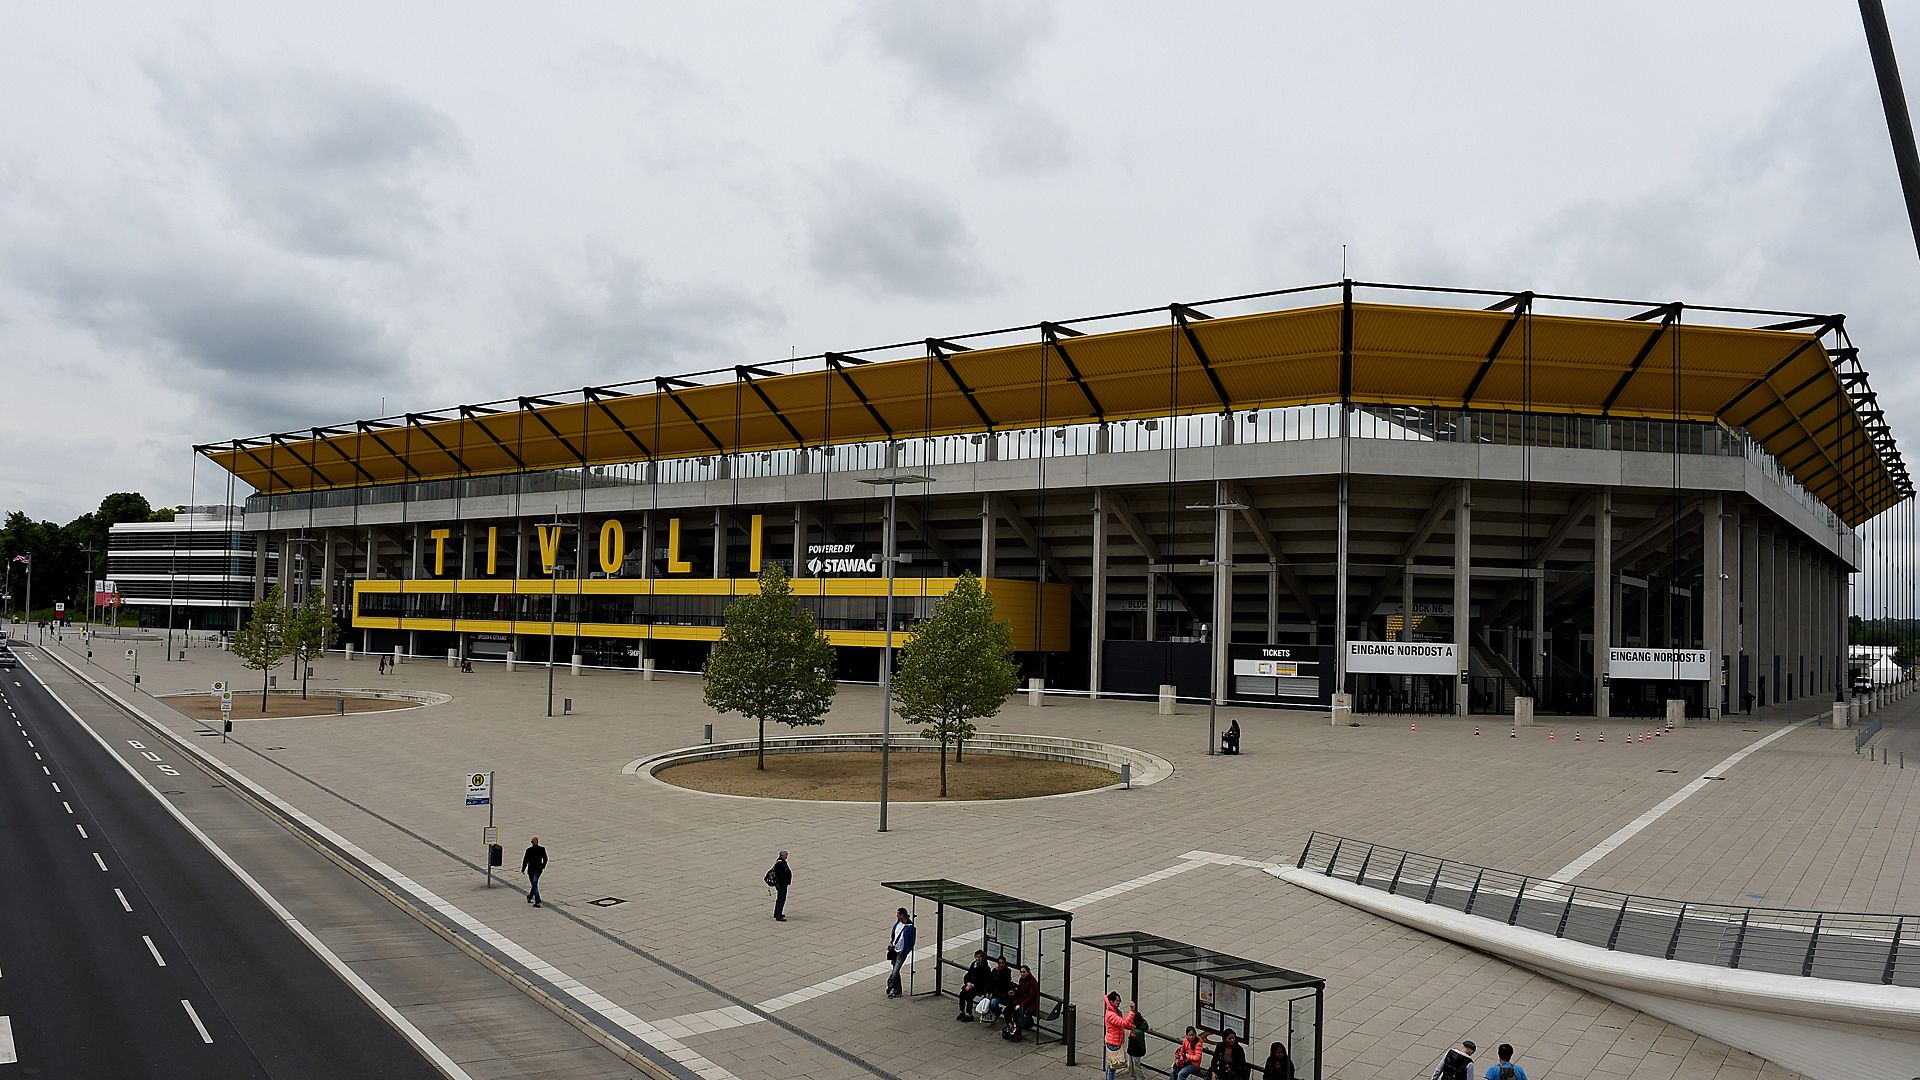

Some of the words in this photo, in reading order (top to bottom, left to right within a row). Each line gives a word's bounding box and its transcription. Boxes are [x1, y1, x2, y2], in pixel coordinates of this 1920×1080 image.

[430, 514, 764, 576] TIVOLI
[808, 544, 843, 554] POWERED
[844, 544, 855, 553] BY
[822, 558, 876, 573] STAWAG
[1128, 600, 1147, 609] BLOC
[1262, 649, 1290, 657] TICKETS
[1351, 644, 1394, 655] EINGANG
[1397, 645, 1443, 656] NORDOST
[1445, 646, 1453, 657] A
[1610, 651, 1651, 662] EINGANG
[1653, 652, 1697, 663] NORDOST
[1699, 653, 1706, 663] B
[127, 740, 181, 776] BUS
